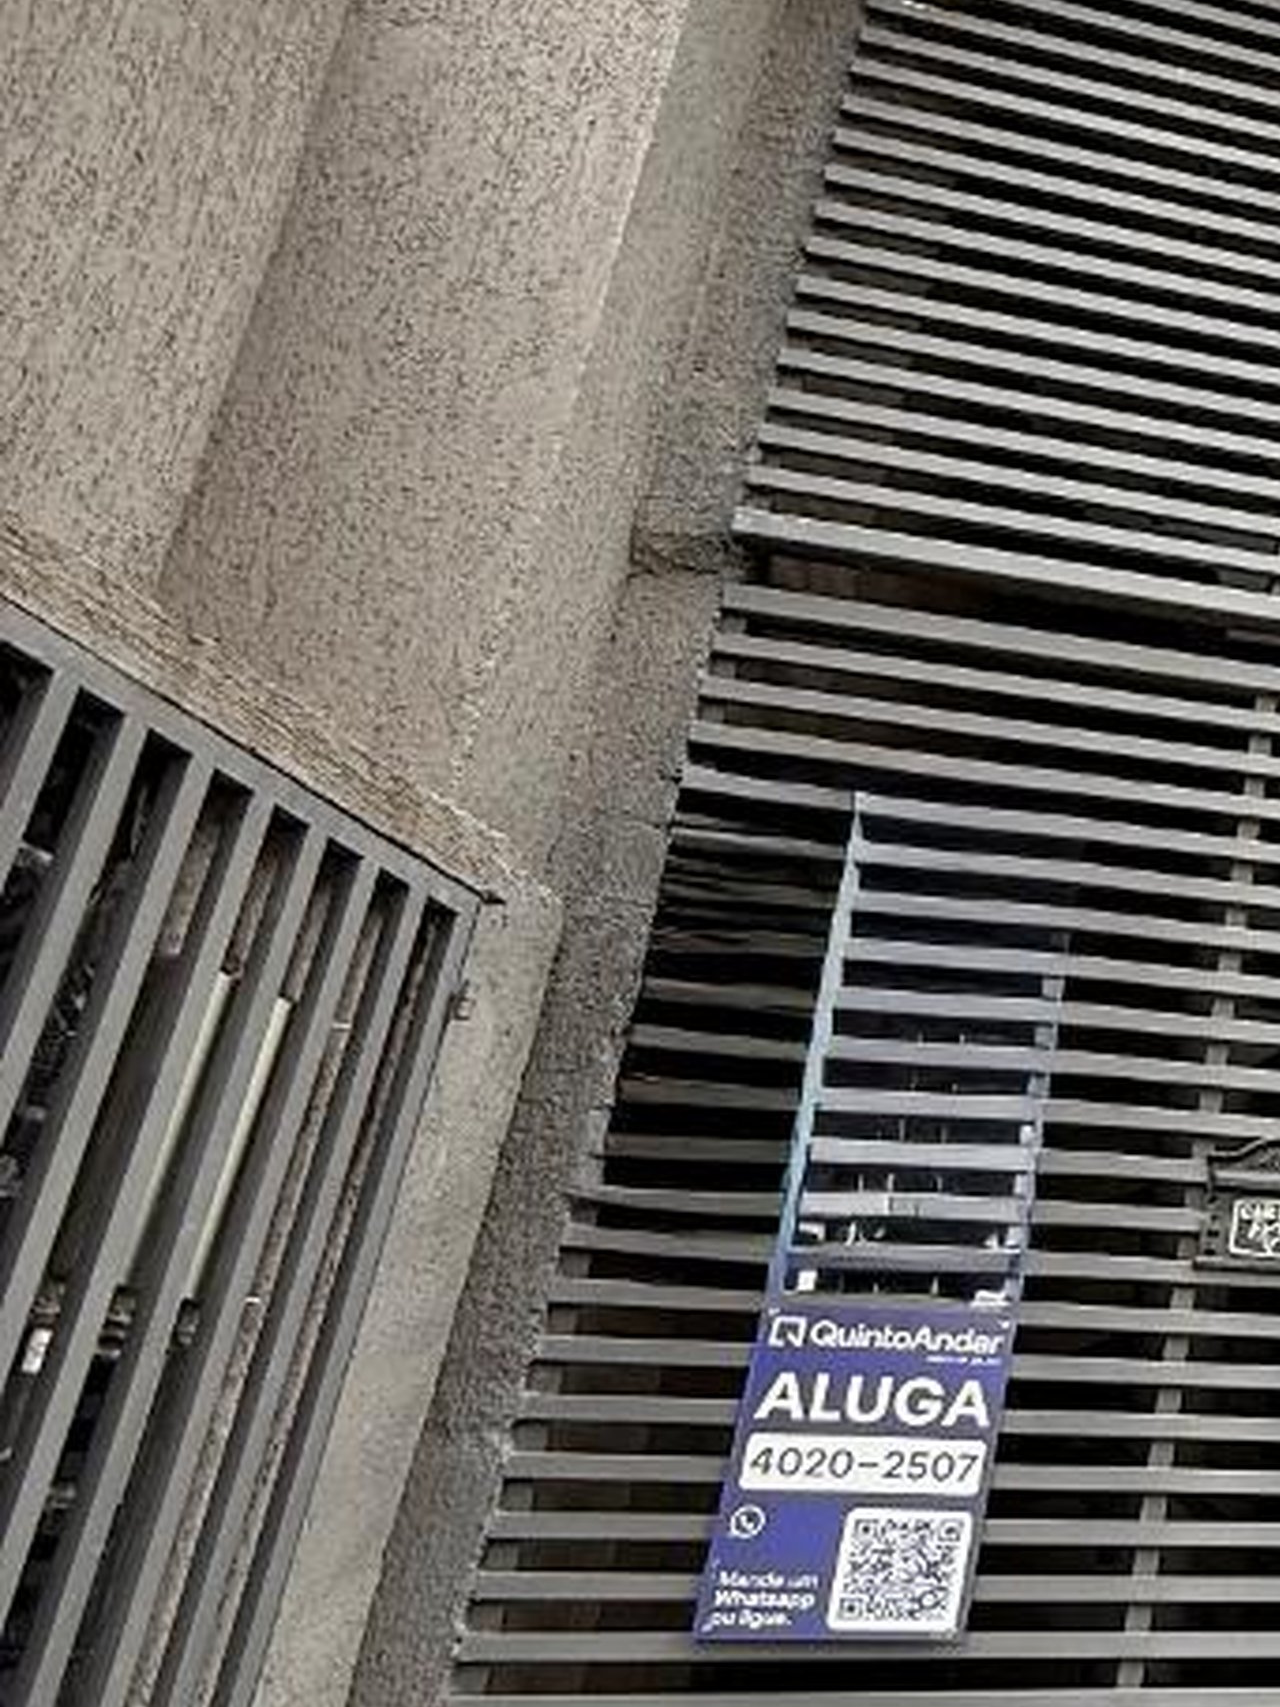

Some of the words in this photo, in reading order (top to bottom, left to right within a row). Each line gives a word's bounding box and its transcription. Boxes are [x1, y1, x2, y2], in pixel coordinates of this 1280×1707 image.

[809, 1319, 1004, 1355] QuintoAndar
[753, 1371, 990, 1428] ALUGA
[750, 1446, 979, 1483] 4020-2507
